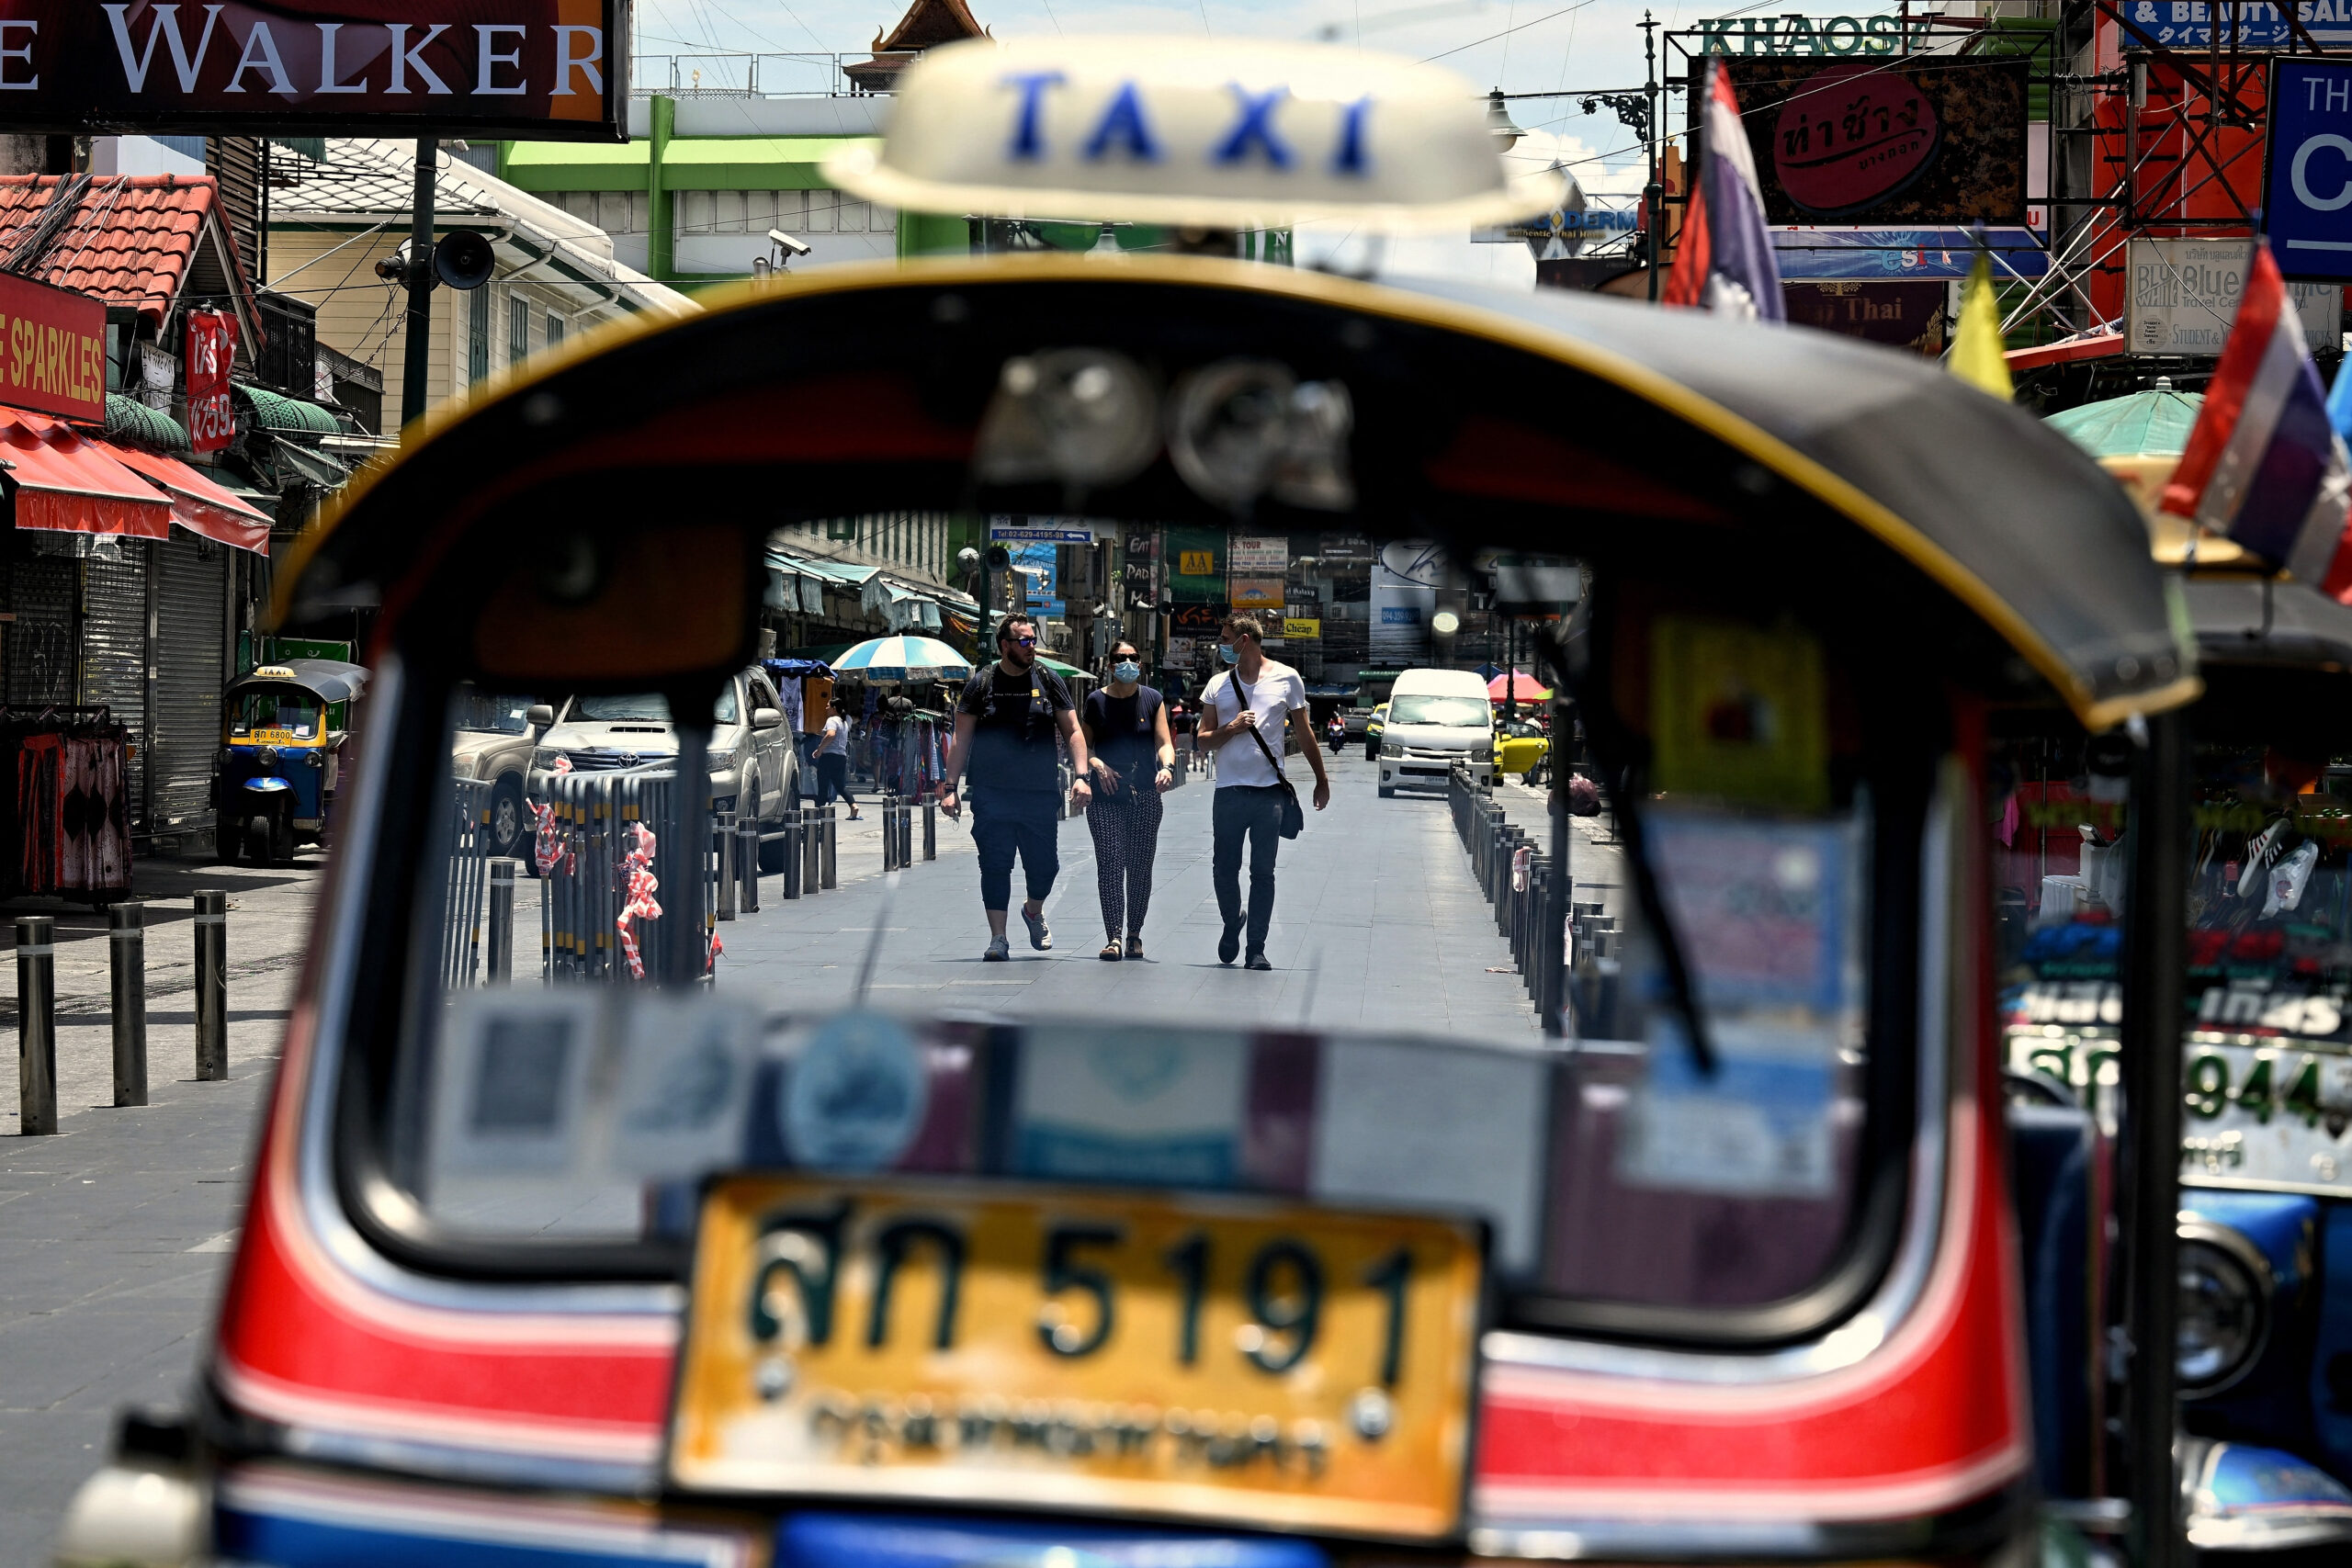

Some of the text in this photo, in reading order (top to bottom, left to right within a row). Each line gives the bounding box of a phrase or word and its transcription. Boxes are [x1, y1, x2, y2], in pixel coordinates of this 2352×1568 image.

[2134, 0, 2352, 22] & BEAUTY SAL
[101, 4, 603, 96] WALKER
[1000, 71, 1374, 177] TAXI
[1783, 96, 1919, 157] ท่าช้าง
[1859, 141, 1919, 171] บางกอก
[2290, 133, 2352, 211] C
[1882, 243, 1928, 269] est
[2183, 264, 2240, 296] Blue
[1846, 297, 1903, 321] Thai
[2182, 296, 2215, 308] Travel
[2172, 323, 2211, 345] STUDENT
[2211, 332, 2220, 344] &
[11, 317, 102, 404] SPARKLES
[1242, 541, 1261, 549] TOUR
[1286, 623, 1312, 634] Cheap
[270, 730, 290, 739] 6800
[747, 1198, 1415, 1386] สก 5191
